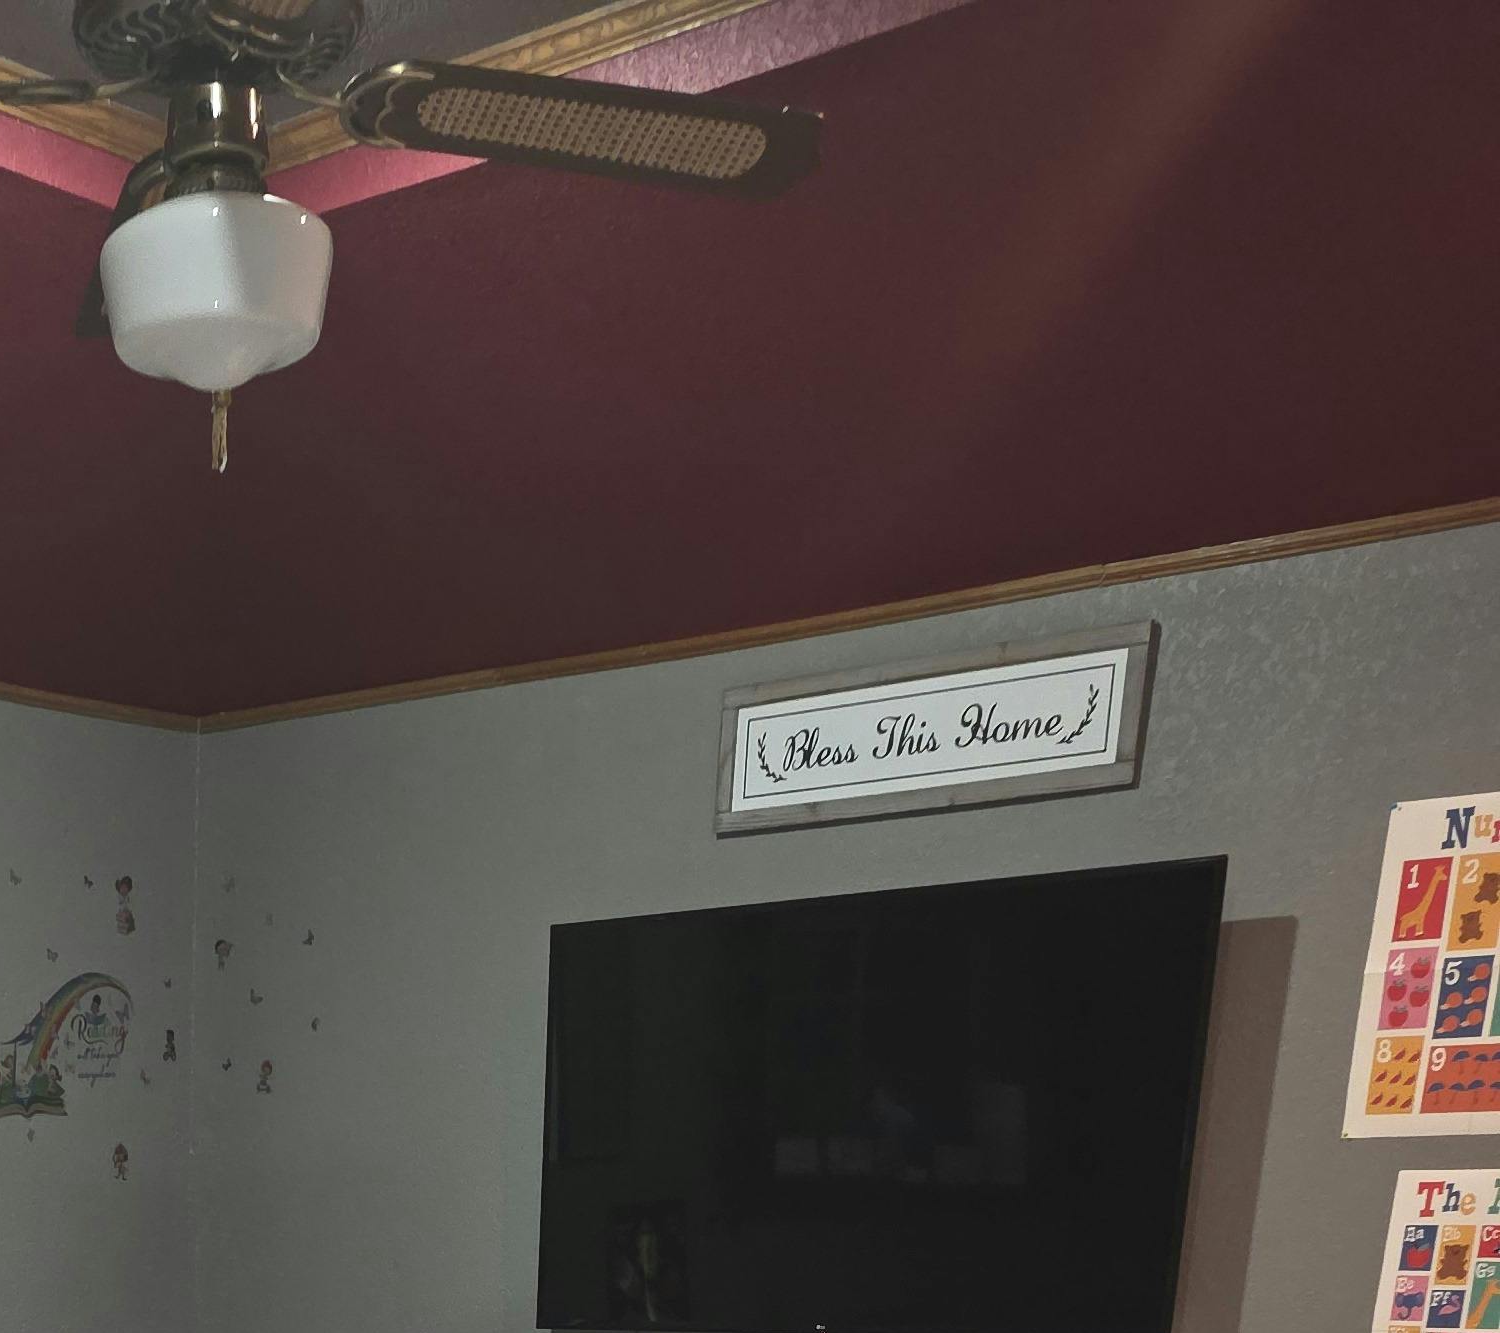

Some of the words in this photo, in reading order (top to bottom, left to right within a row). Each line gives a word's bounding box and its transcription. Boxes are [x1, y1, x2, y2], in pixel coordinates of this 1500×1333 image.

[782, 727, 859, 772] Bless
[872, 712, 941, 760] This
[954, 702, 1065, 749] Home
[1406, 864, 1420, 889] 1
[1462, 859, 1479, 884] 2
[1389, 953, 1405, 976] 4
[1444, 961, 1462, 985] 5
[1376, 1040, 1393, 1063] 8
[1430, 1047, 1446, 1071] 9
[1417, 1180, 1477, 1217] The
